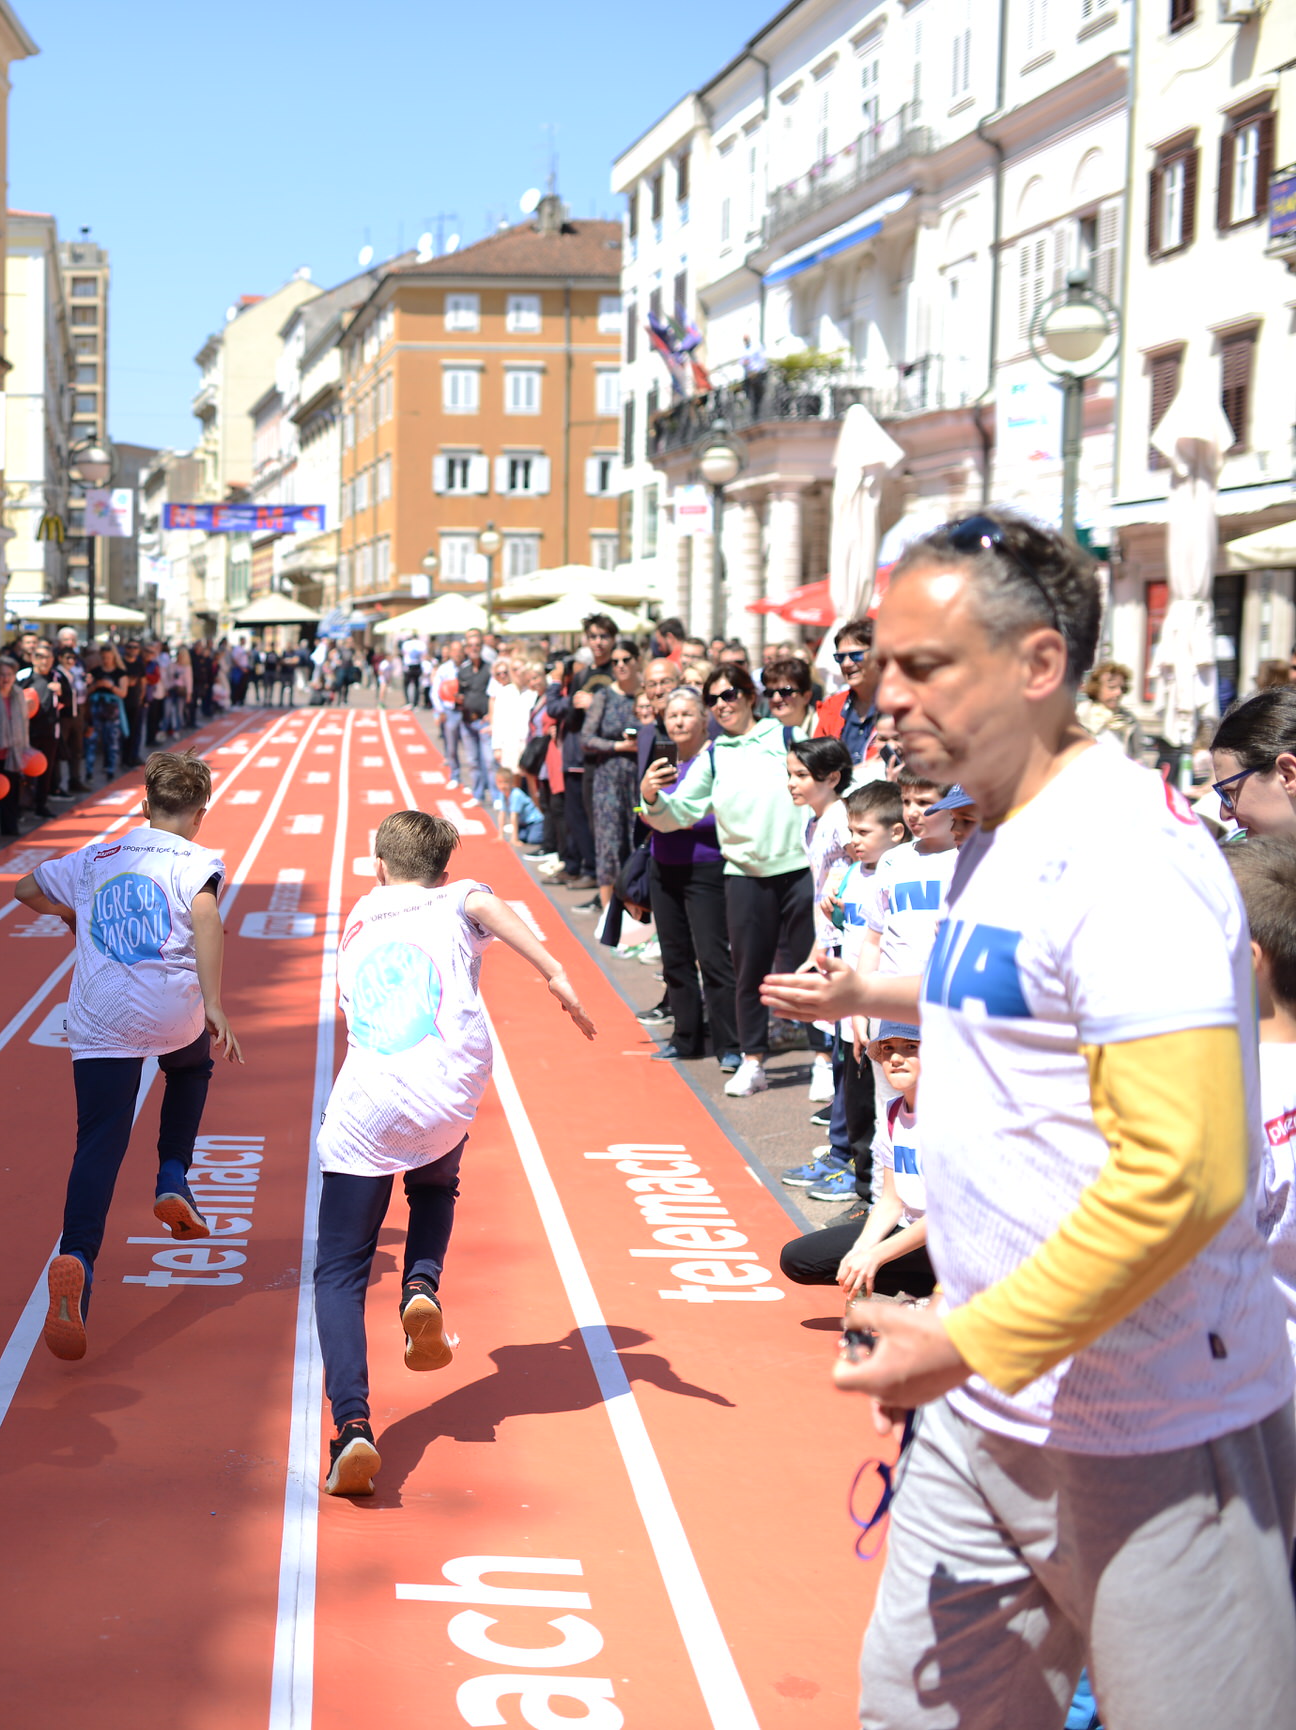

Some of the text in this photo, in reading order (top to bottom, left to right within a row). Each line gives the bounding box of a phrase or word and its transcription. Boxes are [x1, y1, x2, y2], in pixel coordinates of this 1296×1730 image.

[96, 880, 155, 922] IGRE SU
[584, 1143, 785, 1303] telemach
